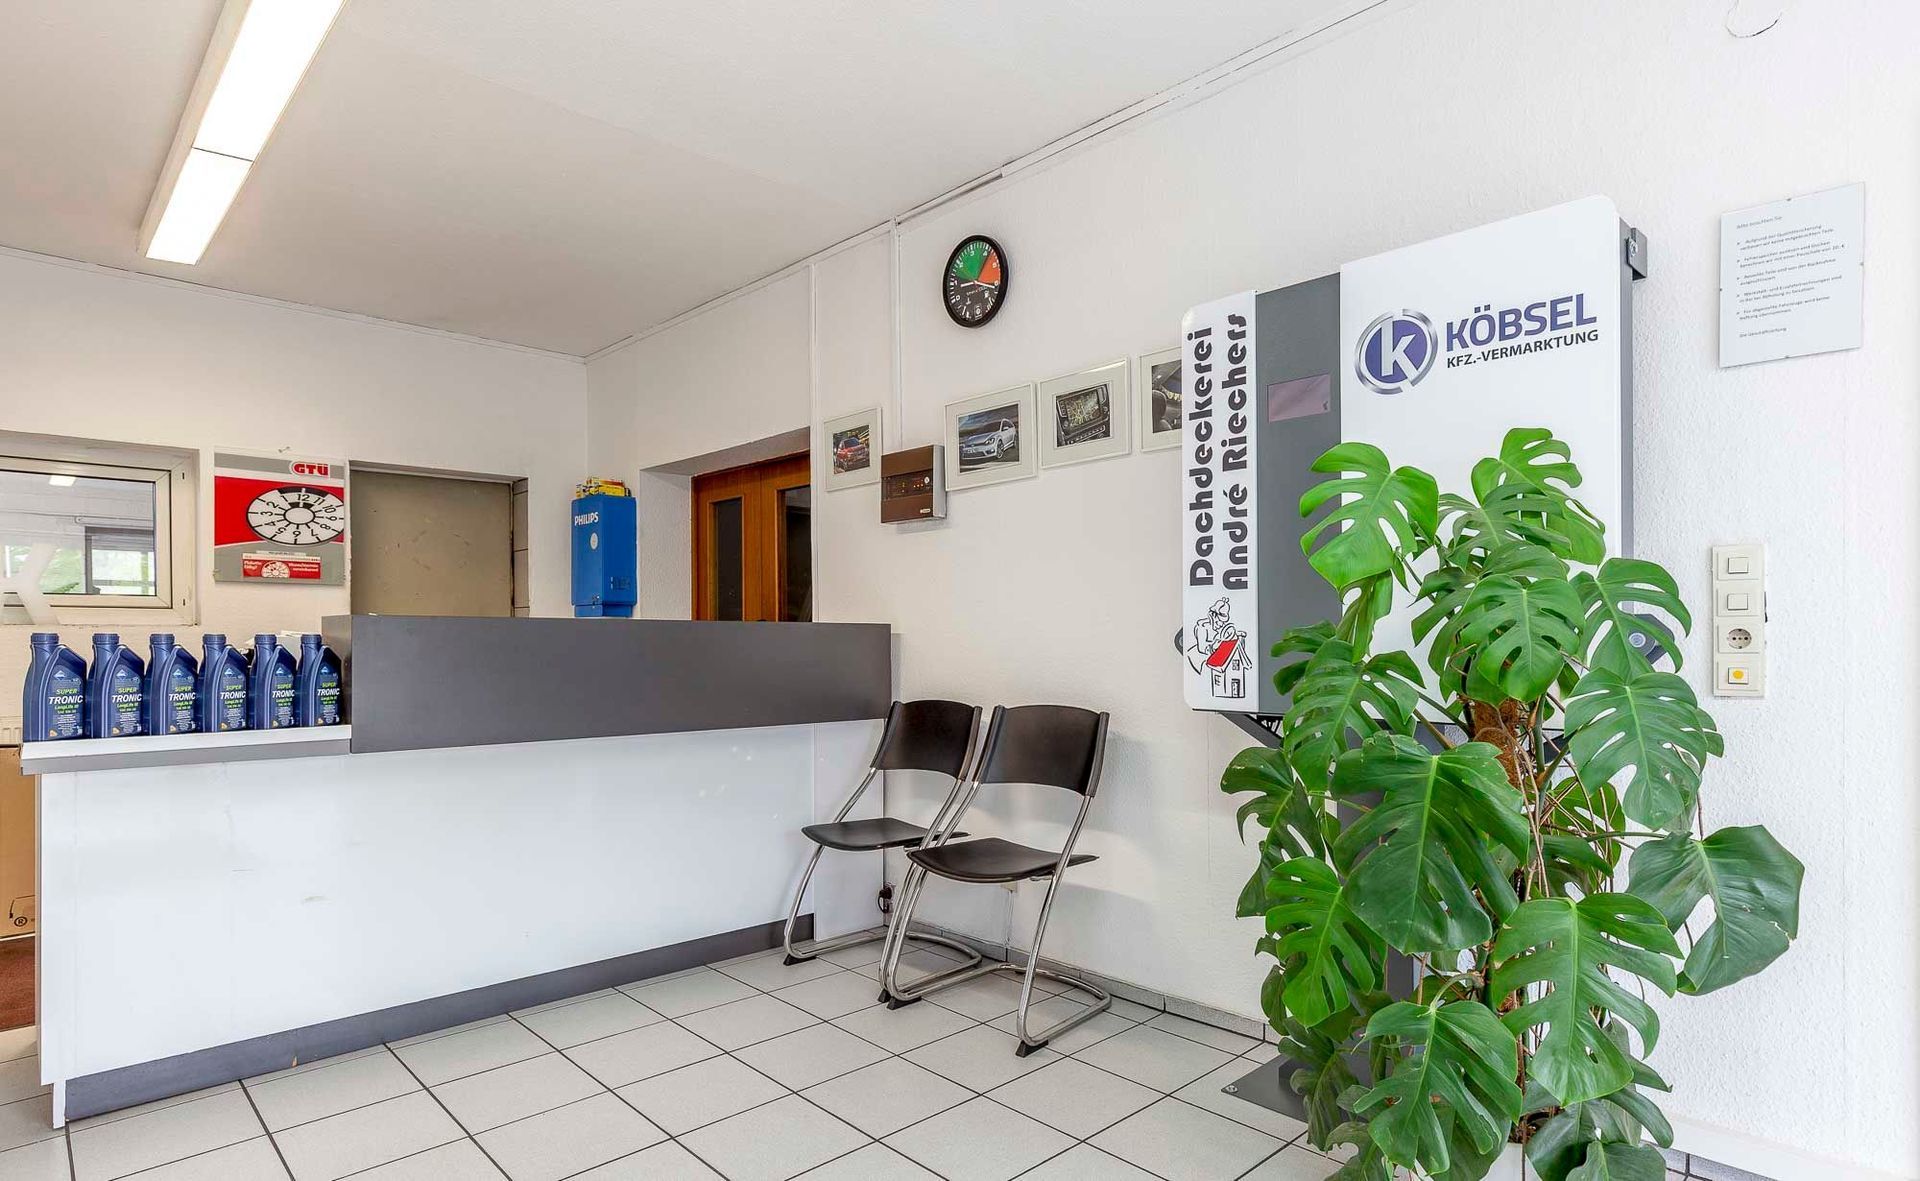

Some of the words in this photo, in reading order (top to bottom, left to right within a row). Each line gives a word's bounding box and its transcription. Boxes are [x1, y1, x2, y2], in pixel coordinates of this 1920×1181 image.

[1446, 293, 1597, 352] KÖBSEL
[1447, 329, 1599, 368] KFZ.-VERMARKTUNG
[1221, 313, 1248, 472] Riechers
[1187, 327, 1214, 586] Dachdeckerei
[293, 463, 329, 476] GTÜ
[297, 493, 310, 502] 12
[314, 497, 325, 505] 11
[266, 501, 279, 509] 2
[322, 504, 336, 514] 10
[574, 511, 599, 526] PHILIPS
[1222, 483, 1248, 590] André
[169, 692, 196, 701] TRONIC
[220, 691, 246, 699] TRONIC
[272, 690, 295, 698] TRONIC
[317, 688, 340, 696] TRONIC
[48, 695, 84, 705] TRONIC
[111, 694, 142, 703] TRONIC
